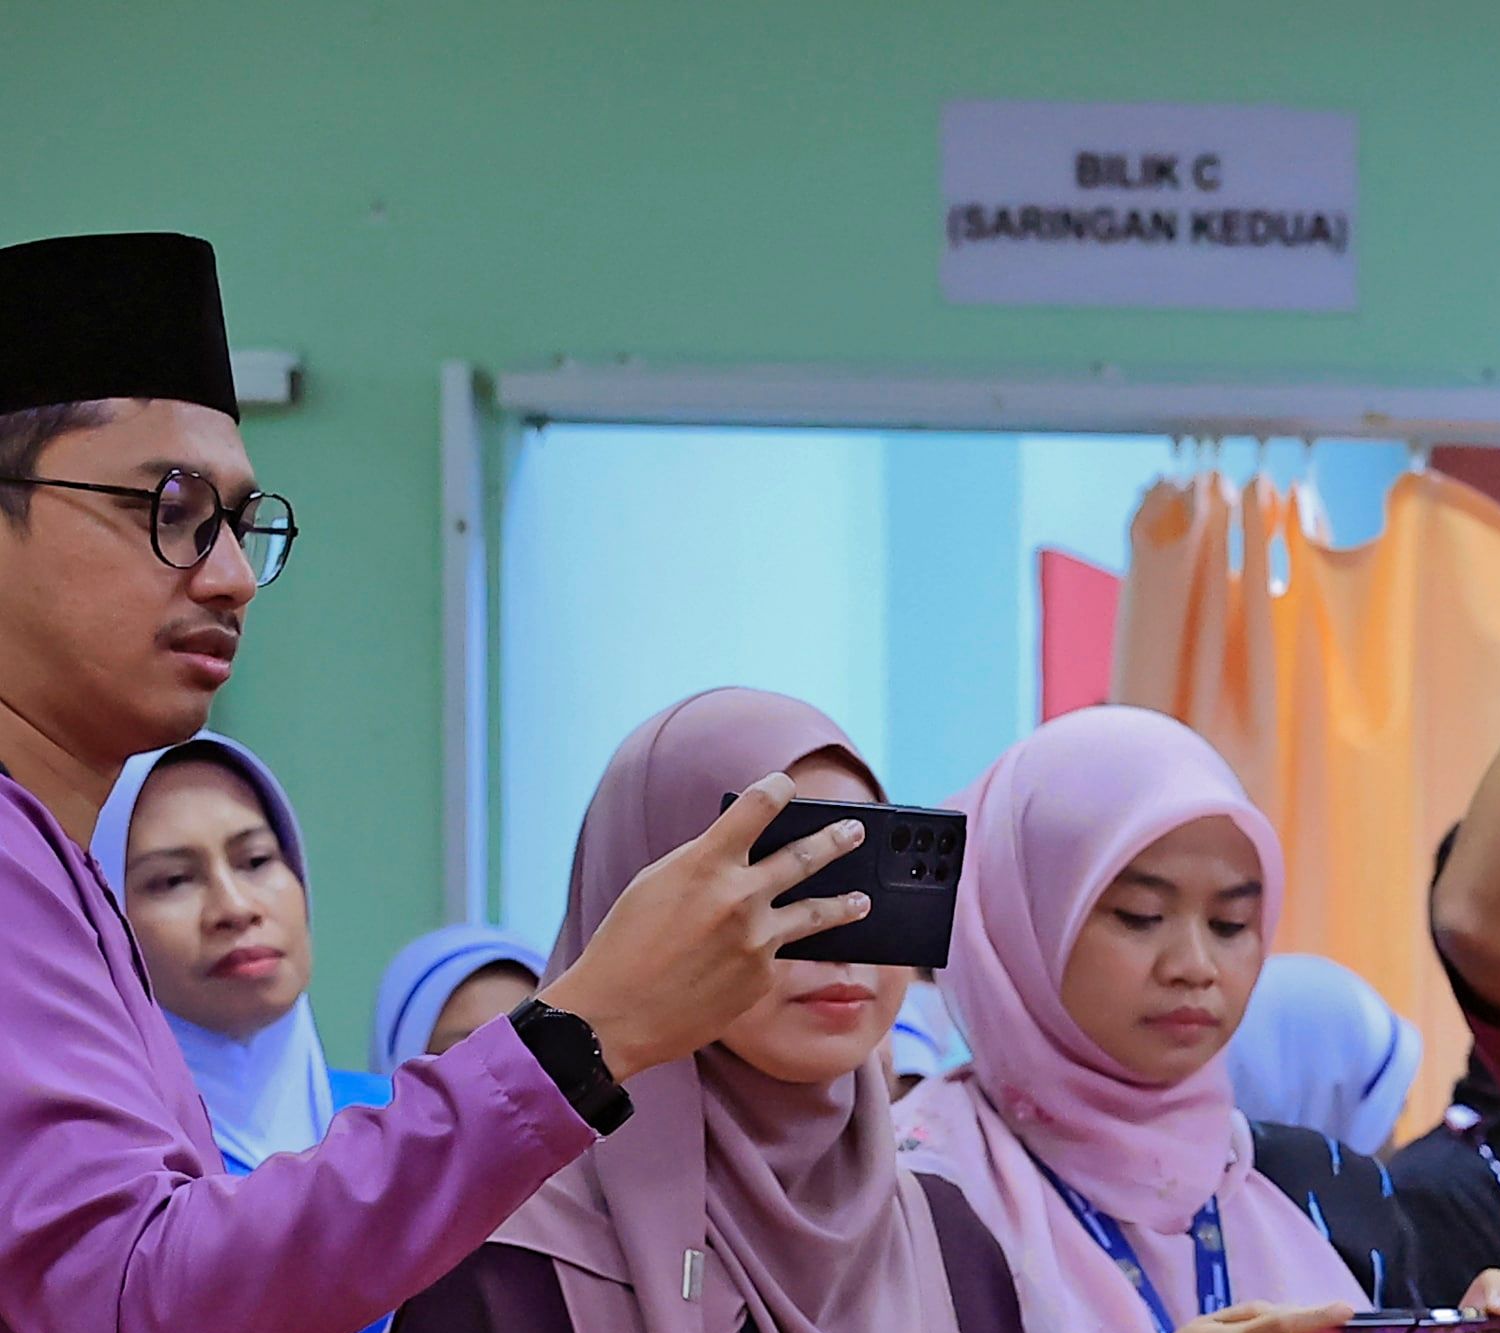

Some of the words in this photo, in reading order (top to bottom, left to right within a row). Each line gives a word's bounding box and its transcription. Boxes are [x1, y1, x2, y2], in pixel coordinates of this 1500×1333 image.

[1075, 151, 1181, 191] BILIK
[1191, 153, 1221, 192] C
[947, 204, 1177, 250] (SARINGAN
[1190, 209, 1348, 253] KEDUA)
